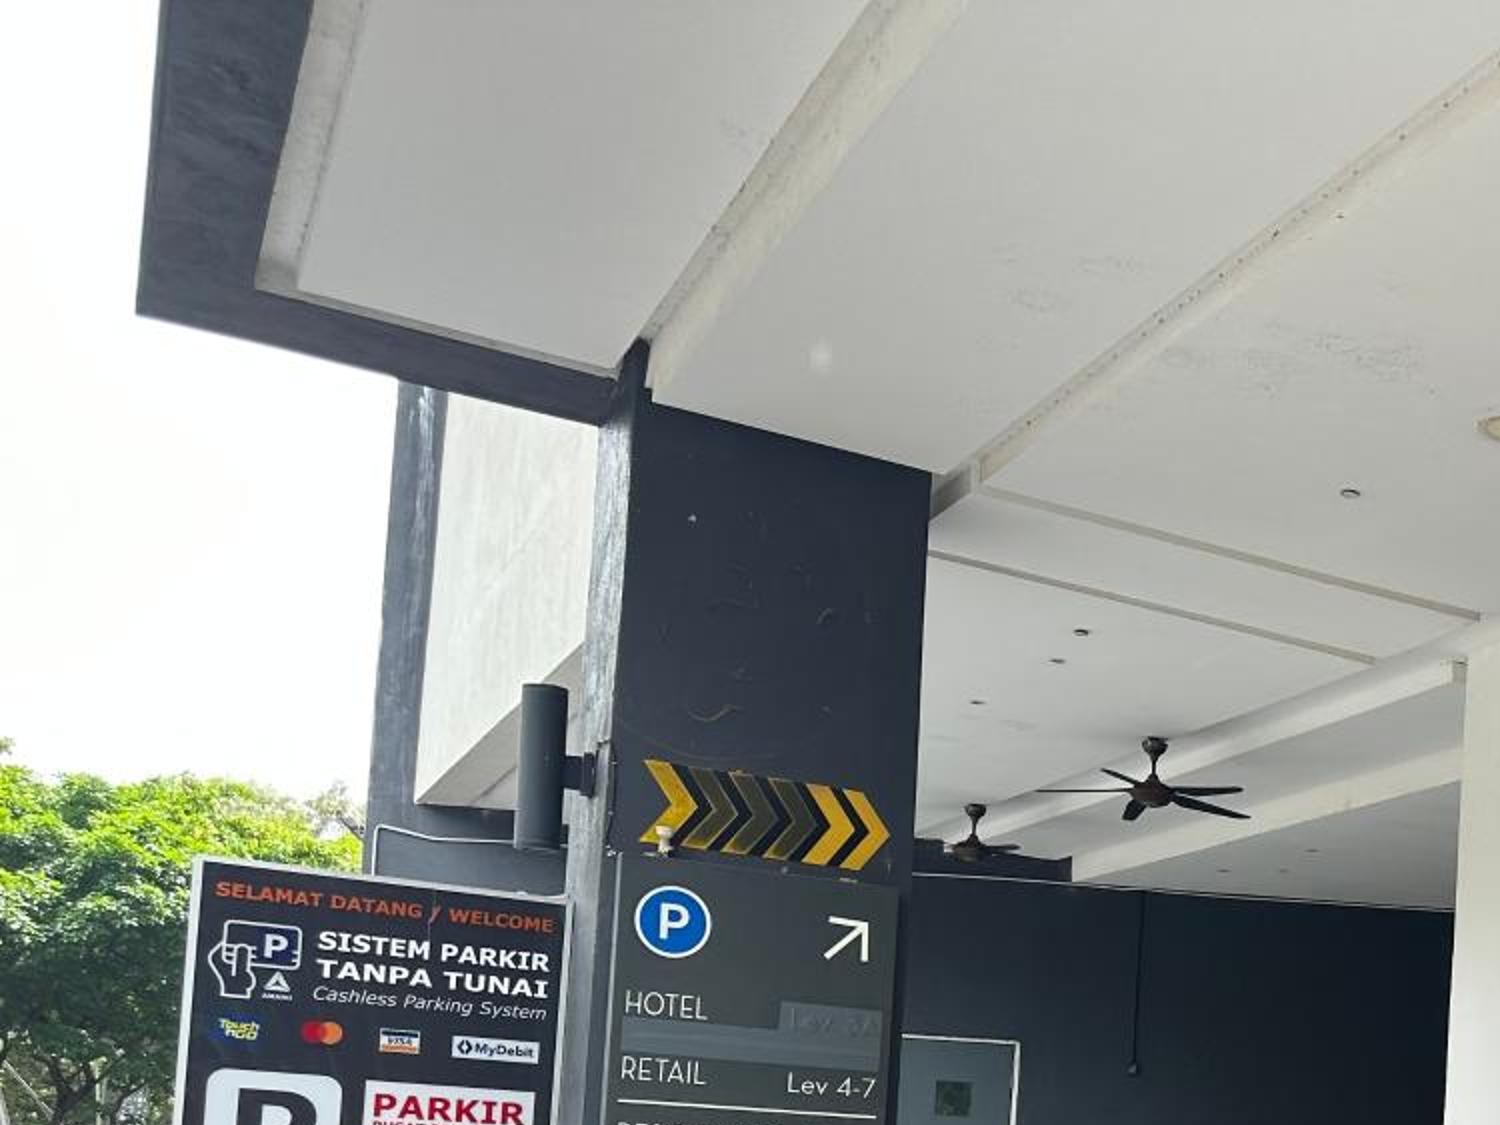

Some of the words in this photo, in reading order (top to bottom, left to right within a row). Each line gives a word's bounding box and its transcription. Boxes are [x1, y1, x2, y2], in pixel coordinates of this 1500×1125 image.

[215, 880, 321, 907] SELAMAT
[330, 896, 423, 918] DATANG
[428, 903, 440, 923] /
[449, 908, 553, 933] WELCOME
[658, 903, 690, 939] P
[264, 933, 288, 958] P
[318, 931, 429, 960] SISTEM
[442, 944, 549, 973] PARKIR
[317, 958, 432, 987] TANPA
[444, 971, 548, 999] TUNAI
[313, 986, 397, 1008] Cashless
[404, 995, 472, 1018] Parking
[479, 1001, 547, 1020] System
[624, 990, 709, 1022] HOTEL
[475, 1043, 534, 1057] MyDebit
[621, 1055, 707, 1086] RETAIL
[787, 1072, 829, 1095] Lev
[836, 1076, 876, 1099] 4-7
